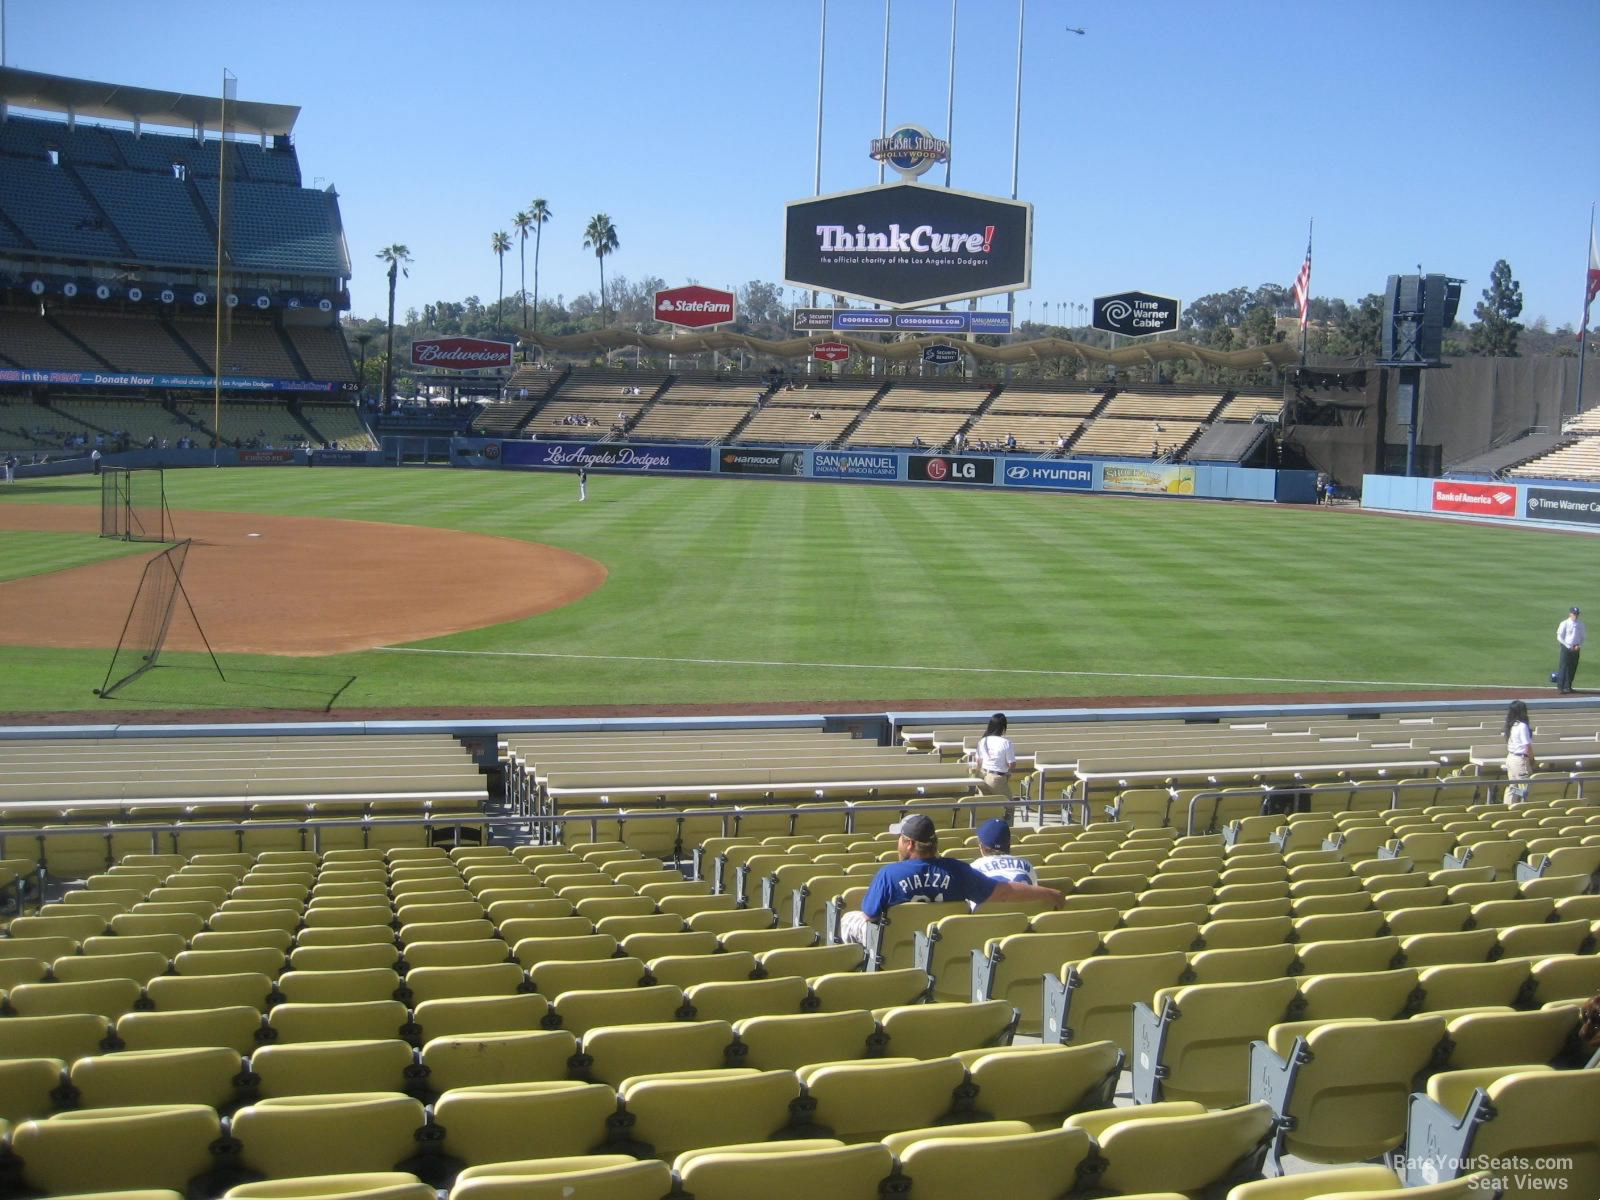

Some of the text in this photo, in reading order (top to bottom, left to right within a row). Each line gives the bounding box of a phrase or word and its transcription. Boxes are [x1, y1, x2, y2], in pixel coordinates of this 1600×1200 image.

[870, 136, 946, 153] UNIVERSAL STUDIOS
[880, 151, 936, 159] HOLLYWOOD
[816, 223, 995, 252] ThinkCure!
[861, 257, 886, 265] charity
[888, 256, 896, 264] of
[925, 257, 955, 265] Angeles
[957, 257, 988, 266] Dodgers
[1134, 300, 1158, 309] Time
[1133, 309, 1169, 318] Warner
[1132, 319, 1161, 327] Cable
[416, 345, 509, 361] Budweiser
[21, 372, 31, 381] in
[33, 372, 49, 381] the
[95, 375, 128, 384] Donate
[130, 376, 154, 385] Now!
[232, 380, 251, 388] Angeles
[253, 381, 274, 389] Dodgers
[543, 445, 670, 470] Los Angeles Dodgers
[815, 455, 895, 469] SAN MANUEL
[952, 462, 976, 478] LG
[1032, 468, 1091, 481] HYUNDAI
[1436, 491, 1491, 504] Bank of America
[1539, 499, 1559, 508] Time
[1559, 500, 1589, 511] Warner
[899, 872, 951, 893] PIAZZA
